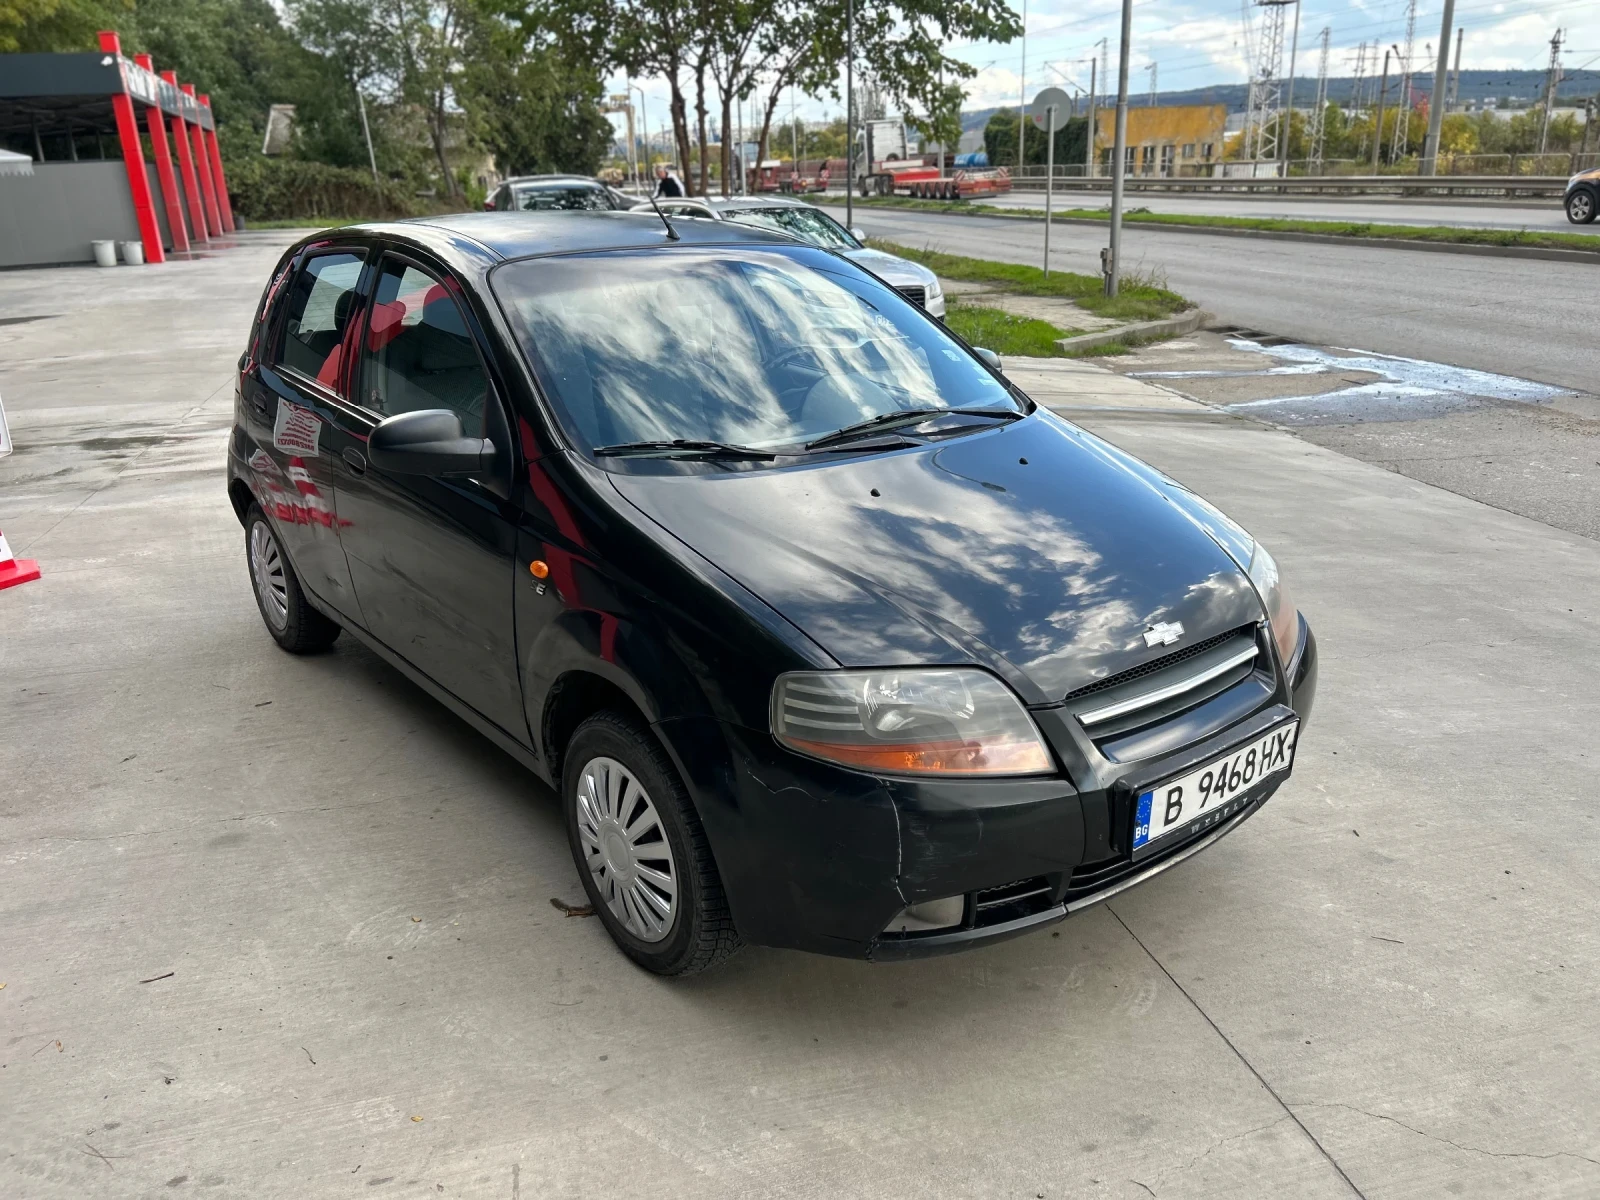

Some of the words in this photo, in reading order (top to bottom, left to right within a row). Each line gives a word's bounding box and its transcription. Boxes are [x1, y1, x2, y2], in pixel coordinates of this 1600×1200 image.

[1164, 786, 1183, 826] B
[1199, 748, 1257, 809] 9468
[1135, 824, 1148, 839] BG
